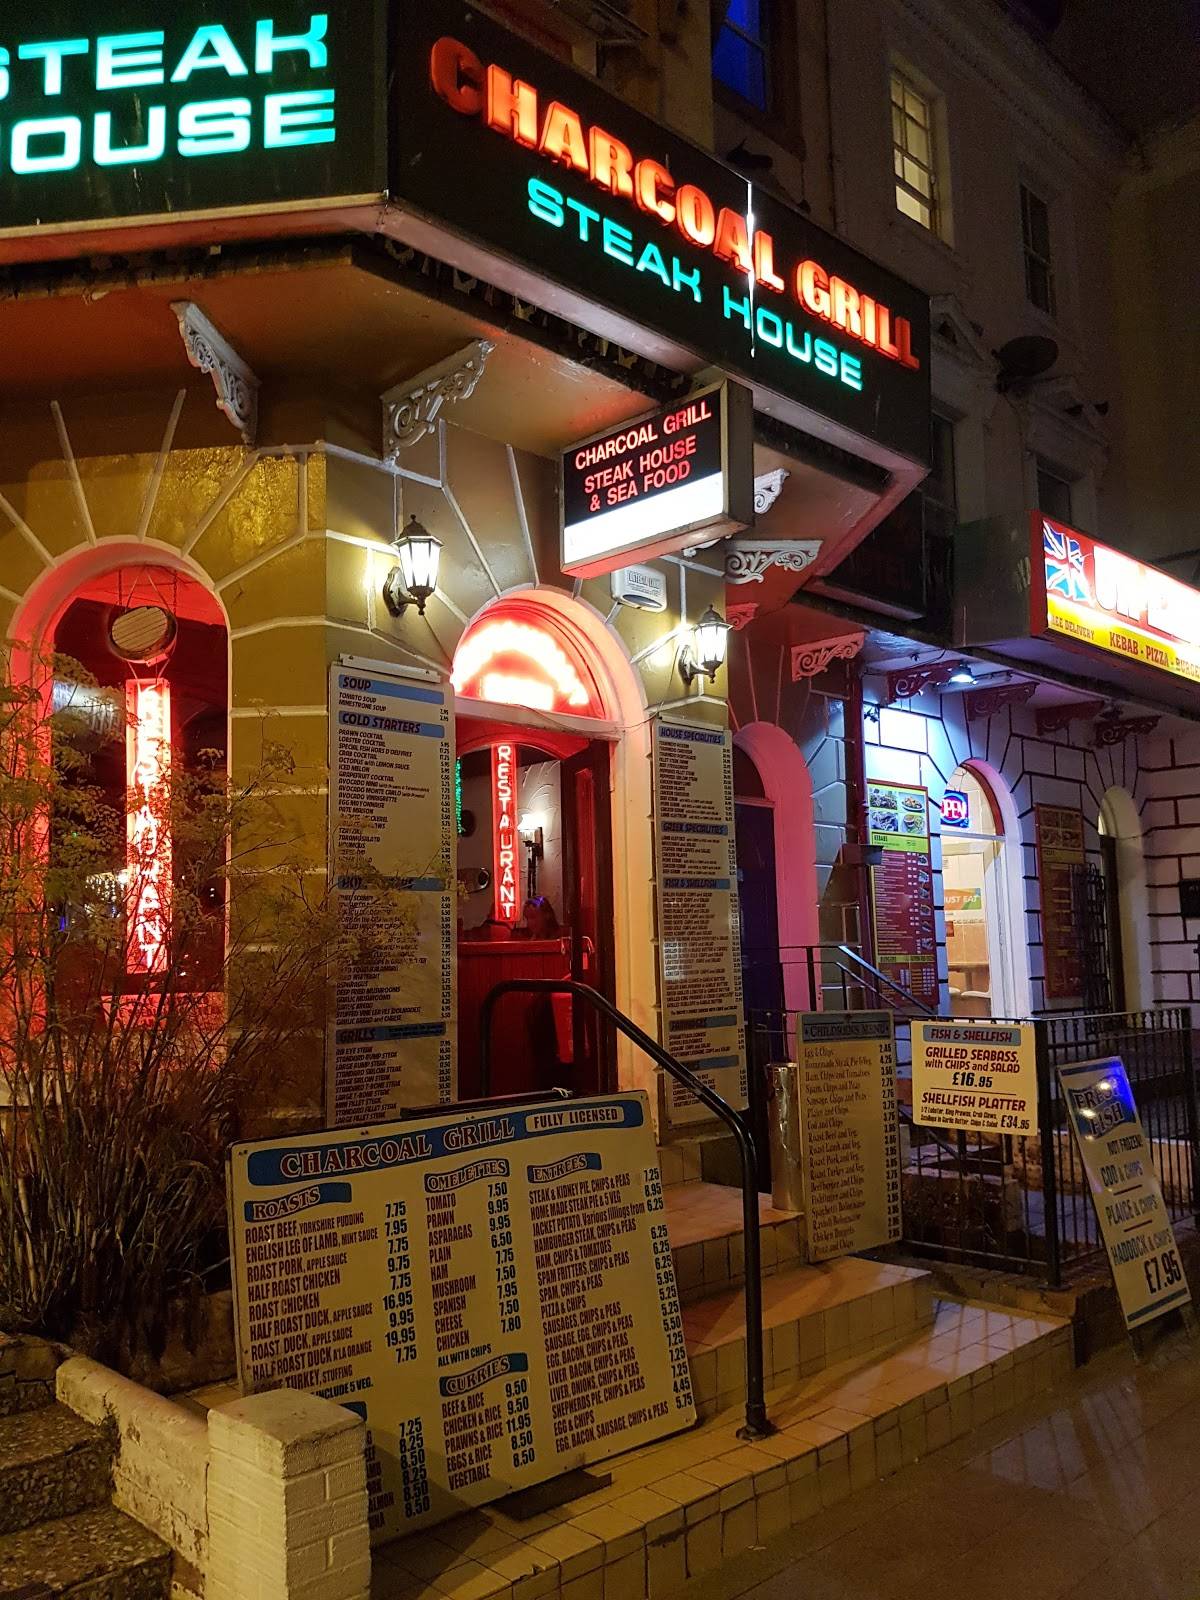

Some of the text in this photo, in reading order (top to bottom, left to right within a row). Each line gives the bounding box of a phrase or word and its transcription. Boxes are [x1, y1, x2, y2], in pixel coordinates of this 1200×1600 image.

[0, 14, 328, 100] TEAK
[10, 89, 336, 174] OUSE
[431, 36, 920, 370] CHARCOAL GRILL
[527, 178, 863, 392] STEAK HOUSE
[575, 400, 712, 470] CHARCOAL GRILL
[585, 435, 697, 494] STEAK HOUSE
[590, 460, 691, 512] & SEA FOOD
[1109, 631, 1139, 656] KEBAB
[1145, 645, 1169, 668] PIZZA
[1175, 657, 1200, 679] BURGE
[339, 691, 377, 703] TOMATO SOUP
[342, 676, 372, 691] SOUP
[342, 713, 421, 734] COLD STARTERS
[373, 704, 387, 712] SOUP
[360, 731, 384, 740] COCKTAIL
[362, 738, 386, 748] COCKTAIL
[660, 727, 682, 739] HOUSE
[135, 688, 162, 969] STAURANT
[497, 745, 516, 918] RESTAURANT
[944, 895, 977, 904] UST EAT
[930, 1028, 1013, 1043] FISH & SHELLFISH
[924, 1059, 1020, 1074] with CHIPS and SALAD
[925, 1046, 1019, 1063] GRILLED SEABASS,
[951, 1071, 993, 1088] £16.95
[1073, 1079, 1120, 1109] FRES
[921, 1091, 1027, 1112] SHELLFISH PLATTER
[1000, 1115, 1030, 1131] £34.95
[1089, 1101, 1125, 1137] FISH
[280, 1108, 618, 1178] CHARCOAL GRILL FULLY LICENSED
[426, 1160, 507, 1192] OMELETTES
[532, 1155, 589, 1182] ENTREES
[1100, 1164, 1118, 1187] COD
[253, 1186, 320, 1221] ROASTS
[425, 1181, 508, 1212] TOMATO 7.50
[528, 1188, 551, 1205] STEAK
[555, 1182, 580, 1199] KIDNEY
[590, 1176, 610, 1192] CHIPS
[615, 1173, 631, 1186] PEAS
[245, 1201, 406, 1244] ROAST BEEF, YORKSHIRE PUDDING 7.75
[427, 1198, 509, 1230] PRAWN 9.95
[1105, 1199, 1134, 1227] PLAICE
[246, 1219, 408, 1264] ENGLISH LEG OF LAMB, MINT SAUCE 7.95
[428, 1214, 511, 1247] ASPARAGAS 9.95
[247, 1237, 409, 1284] ROAST PORK, APPLE SAUCE 7.75
[429, 1231, 512, 1264] PLAIN 6.50
[1110, 1235, 1148, 1266] HADDOCK
[248, 1254, 410, 1303] HALF ROAST CHICKEN 9.75
[430, 1248, 514, 1282] HAM 7.75
[1143, 1249, 1182, 1295] £7.95
[248, 1273, 412, 1322] ROAST CHICKEN 7.75
[431, 1264, 516, 1300] MUSHROOM 7.50
[382, 1290, 413, 1311] 16.95
[433, 1281, 518, 1317] SPANISH 7.95
[540, 1294, 587, 1320] PIZZA & CHIPS
[389, 1308, 415, 1329] 9.95
[435, 1298, 520, 1335] CHEESE 7.50
[384, 1326, 416, 1348] 19.95
[436, 1315, 521, 1353] CHICKEN 7.80
[395, 1344, 417, 1364] 7.75
[438, 1343, 492, 1368] ALL WITH CHIPS
[445, 1357, 511, 1395] CURRIES
[443, 1395, 530, 1437] CHICKEN & RICE 9.50
[553, 1420, 568, 1437] EGG
[574, 1410, 595, 1430] CHIPS
[448, 1447, 536, 1491] VEGETABLE 8.50
